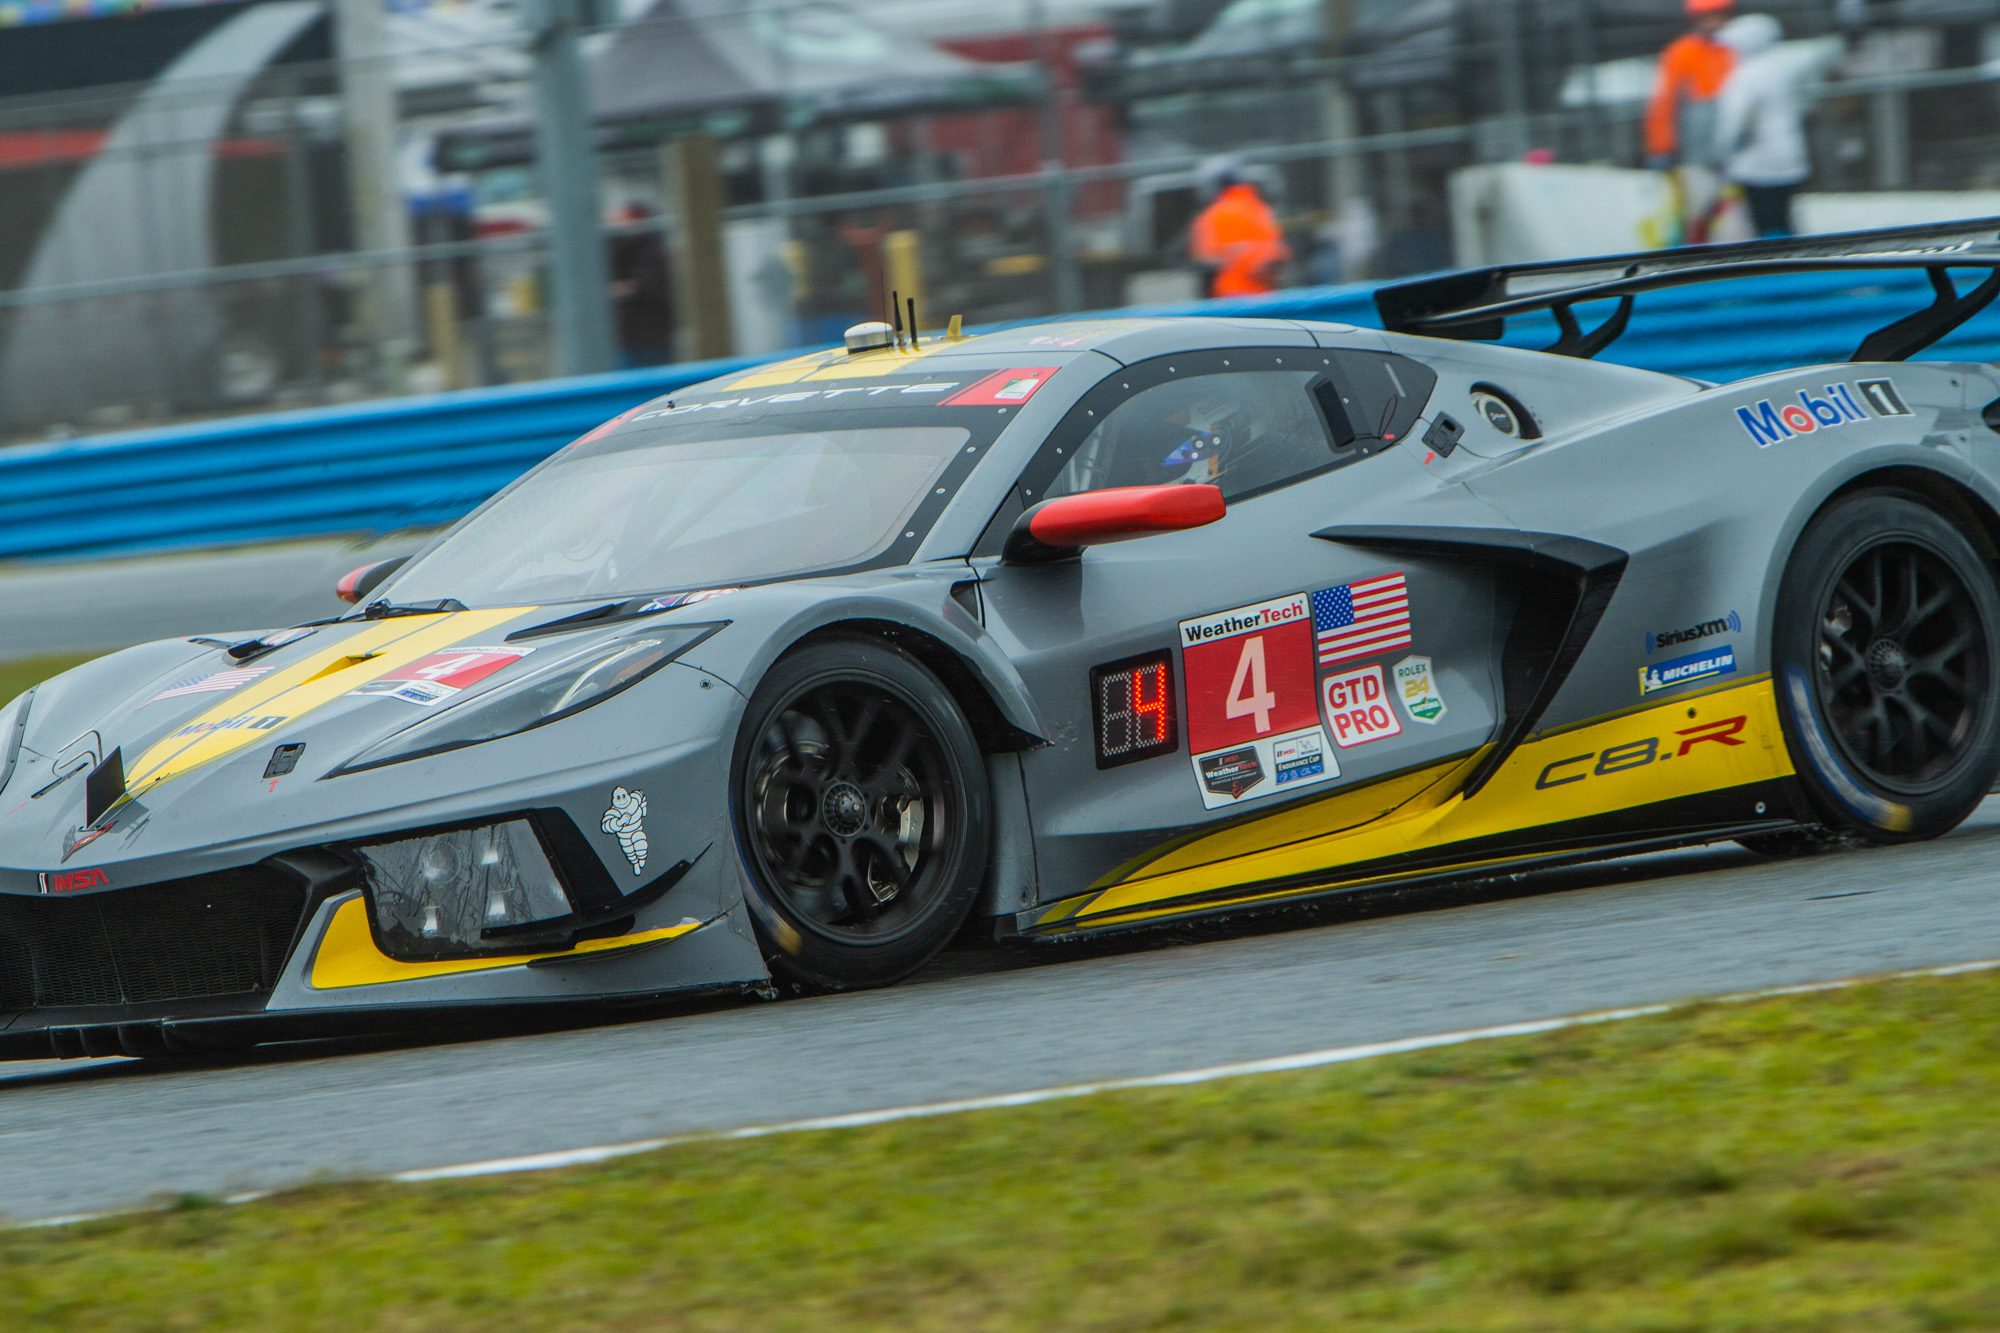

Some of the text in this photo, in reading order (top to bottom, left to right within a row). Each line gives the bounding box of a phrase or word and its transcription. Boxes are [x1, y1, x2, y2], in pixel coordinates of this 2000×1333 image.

[631, 382, 961, 422] CORVETTE
[1735, 383, 1869, 447] Mobil
[1185, 602, 1303, 642] WeatherTech
[415, 653, 484, 680] 4
[1398, 663, 1427, 678] ROLEX
[1662, 654, 1734, 681] MICHELIN
[1133, 661, 1166, 742] 4
[1225, 635, 1276, 734] 4
[1328, 674, 1380, 709] GTD
[1404, 676, 1430, 699] 24
[169, 716, 257, 739] Mobil
[1333, 704, 1390, 739] PRO
[1535, 715, 1748, 791] C8.R
[53, 867, 110, 893] IMSA
